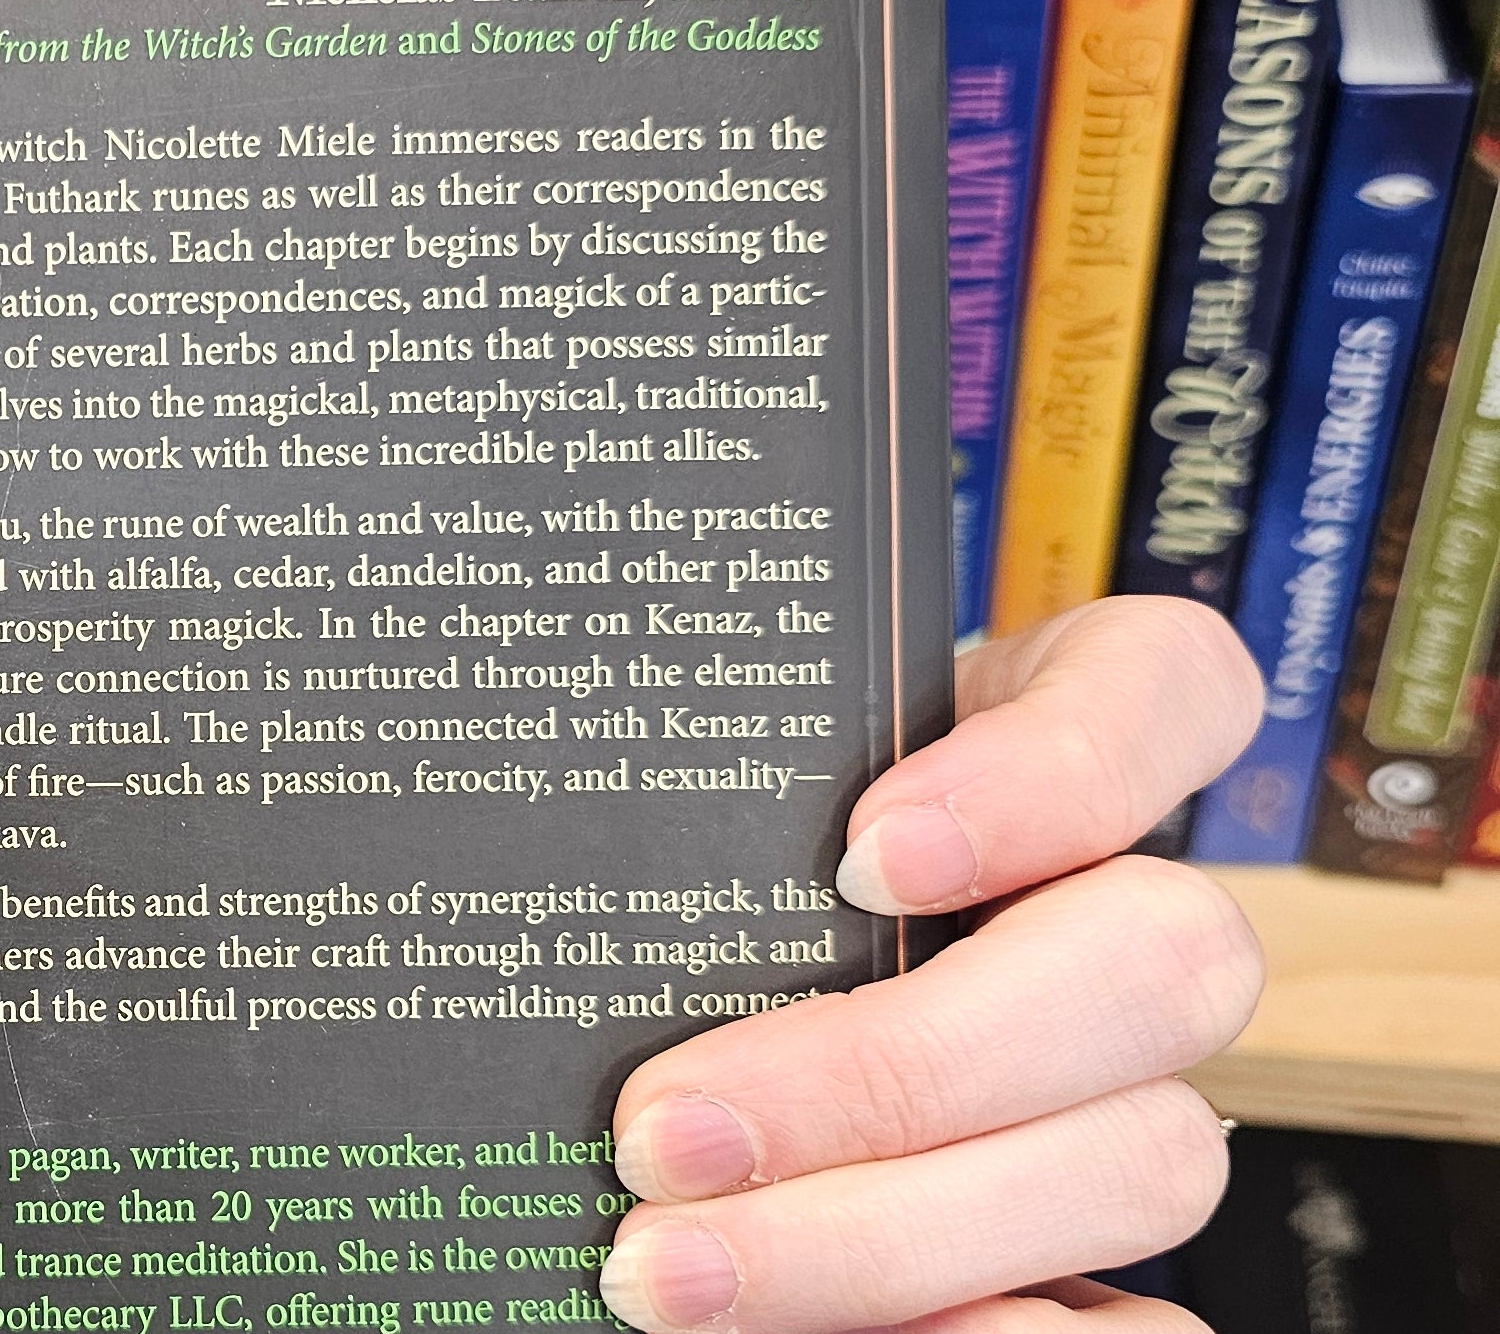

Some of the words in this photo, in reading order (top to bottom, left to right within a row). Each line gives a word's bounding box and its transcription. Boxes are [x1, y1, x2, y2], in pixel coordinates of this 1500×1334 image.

[82, 28, 130, 61] the
[144, 25, 253, 60] Witch’s
[266, 23, 386, 57] Garden
[399, 19, 461, 54] and
[472, 23, 575, 53] Stones
[587, 18, 623, 62] of
[628, 18, 678, 51] the
[688, 16, 822, 51] Goddess
[104, 125, 261, 160] Nicolette
[277, 123, 375, 157] Miele
[392, 124, 562, 154] immerses
[577, 116, 706, 151] readers
[719, 118, 754, 150] in
[770, 116, 827, 150] the
[1062, 29, 1169, 269] Animal
[1199, 208, 1268, 273] OF
[1182, 276, 1258, 363] THE
[1040, 277, 1122, 464] Magic
[1146, 349, 1272, 565] Witch
[9, 1148, 120, 1189] pagan,
[130, 1139, 239, 1173] writer,
[250, 1146, 330, 1169] rune
[338, 1133, 466, 1169] worker,
[475, 1131, 539, 1166] and
